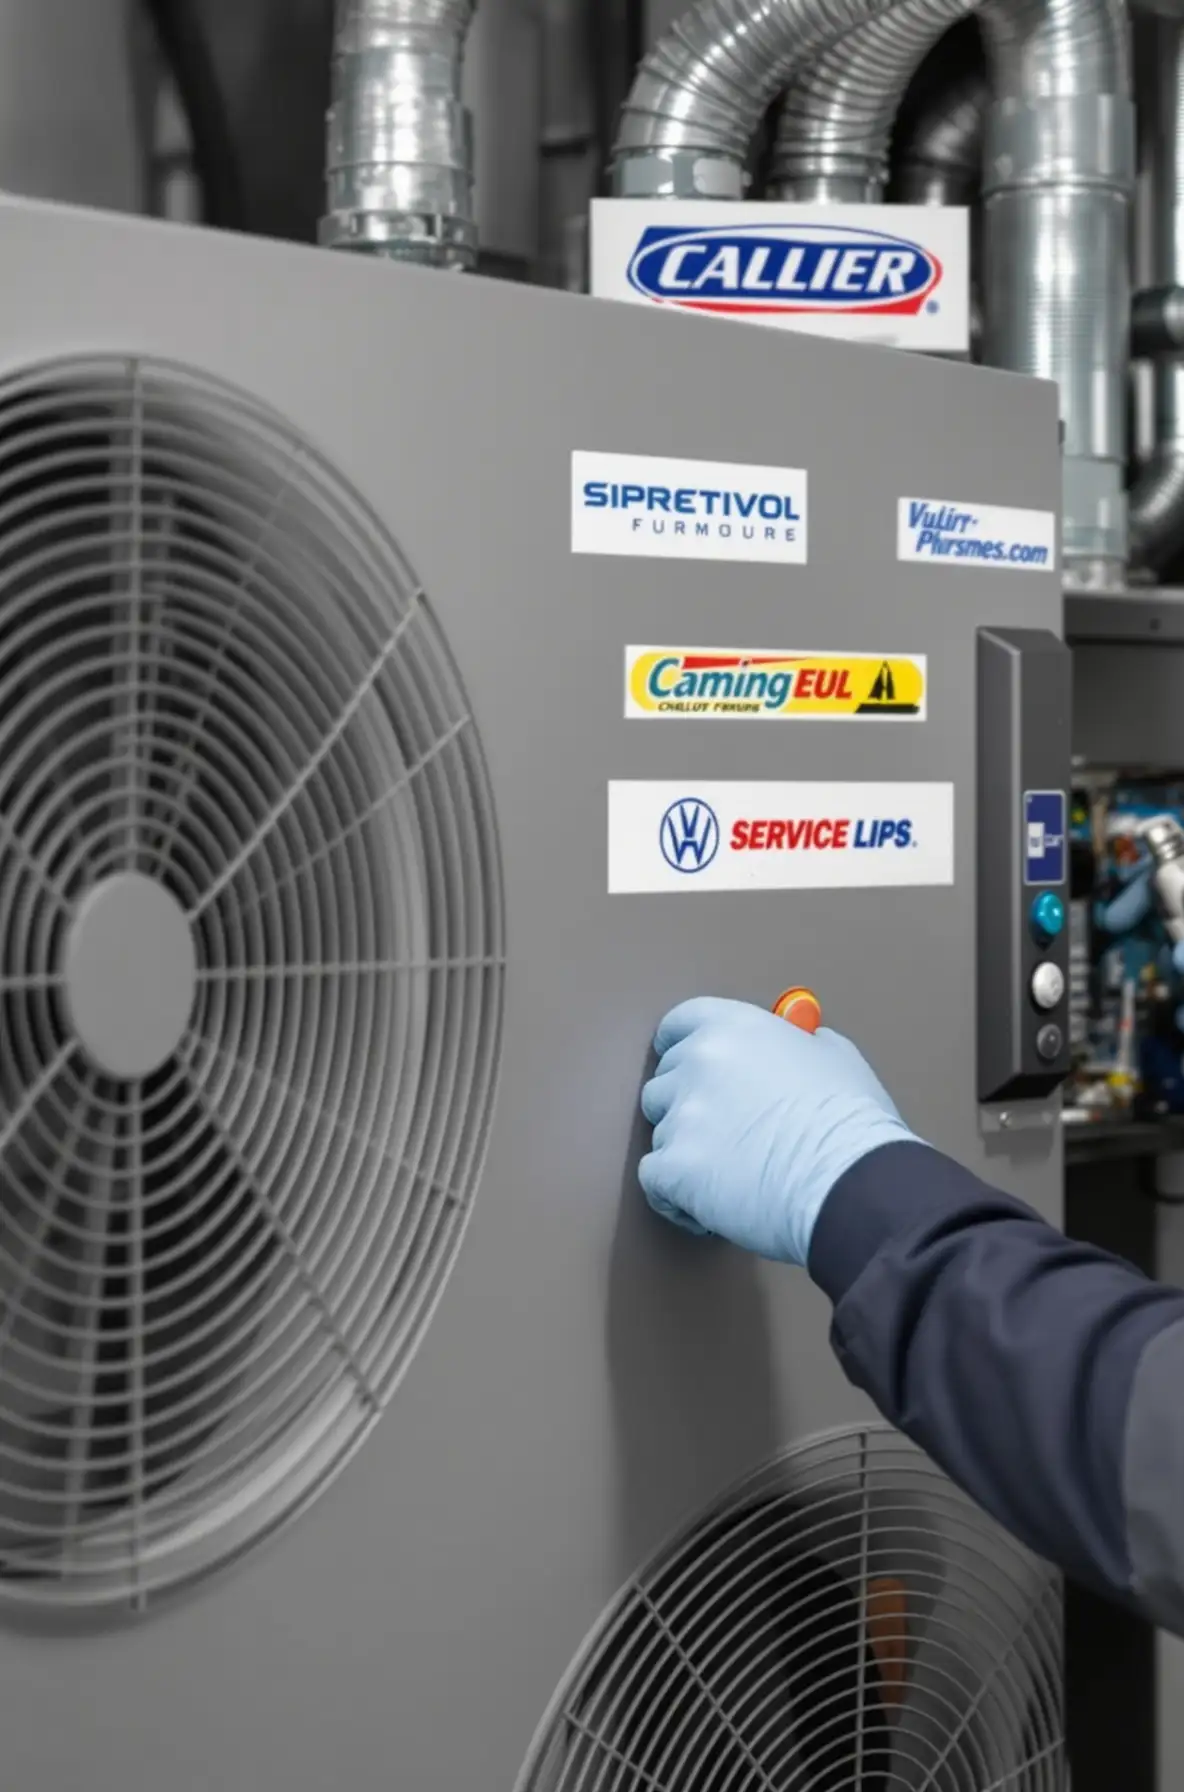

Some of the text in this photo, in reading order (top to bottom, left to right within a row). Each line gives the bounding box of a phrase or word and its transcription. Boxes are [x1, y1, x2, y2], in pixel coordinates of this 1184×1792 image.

[656, 244, 919, 294] CALLIER
[583, 480, 800, 521] SIPRETIVOL
[632, 517, 796, 543] FURMOURE
[730, 818, 850, 851] SERVICE
